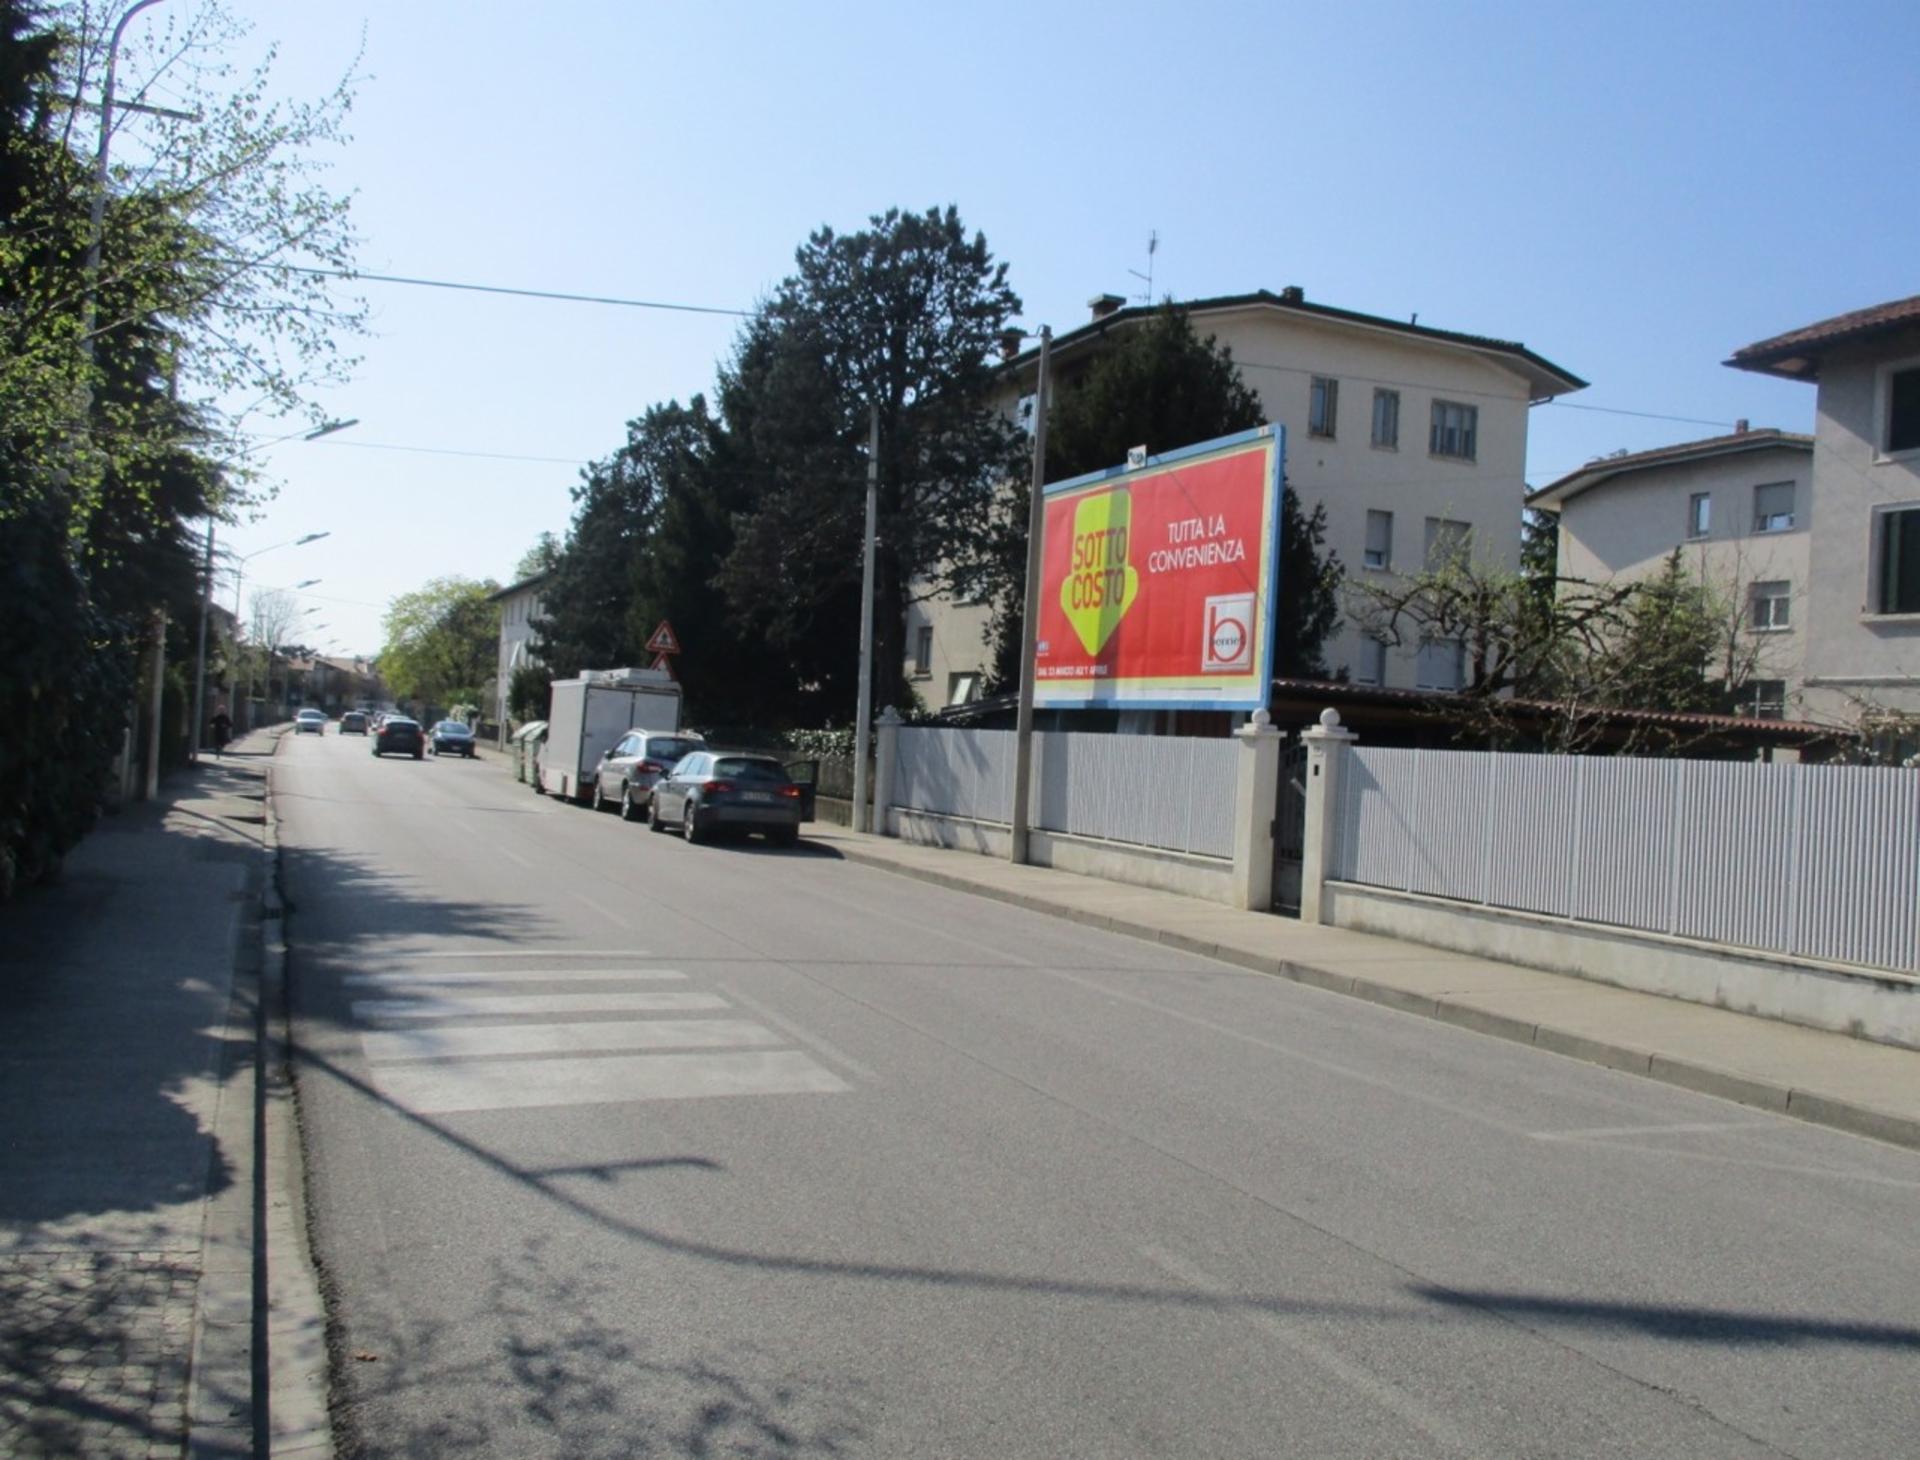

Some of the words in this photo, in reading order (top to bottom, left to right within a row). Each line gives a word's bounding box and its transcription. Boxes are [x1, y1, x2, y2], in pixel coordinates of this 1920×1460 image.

[1073, 526, 1127, 570] SOTTO
[1168, 517, 1204, 544] TUTTA
[1208, 513, 1226, 538] LA
[1148, 538, 1246, 573] CONVENIENZA
[1071, 567, 1126, 610] COSTO
